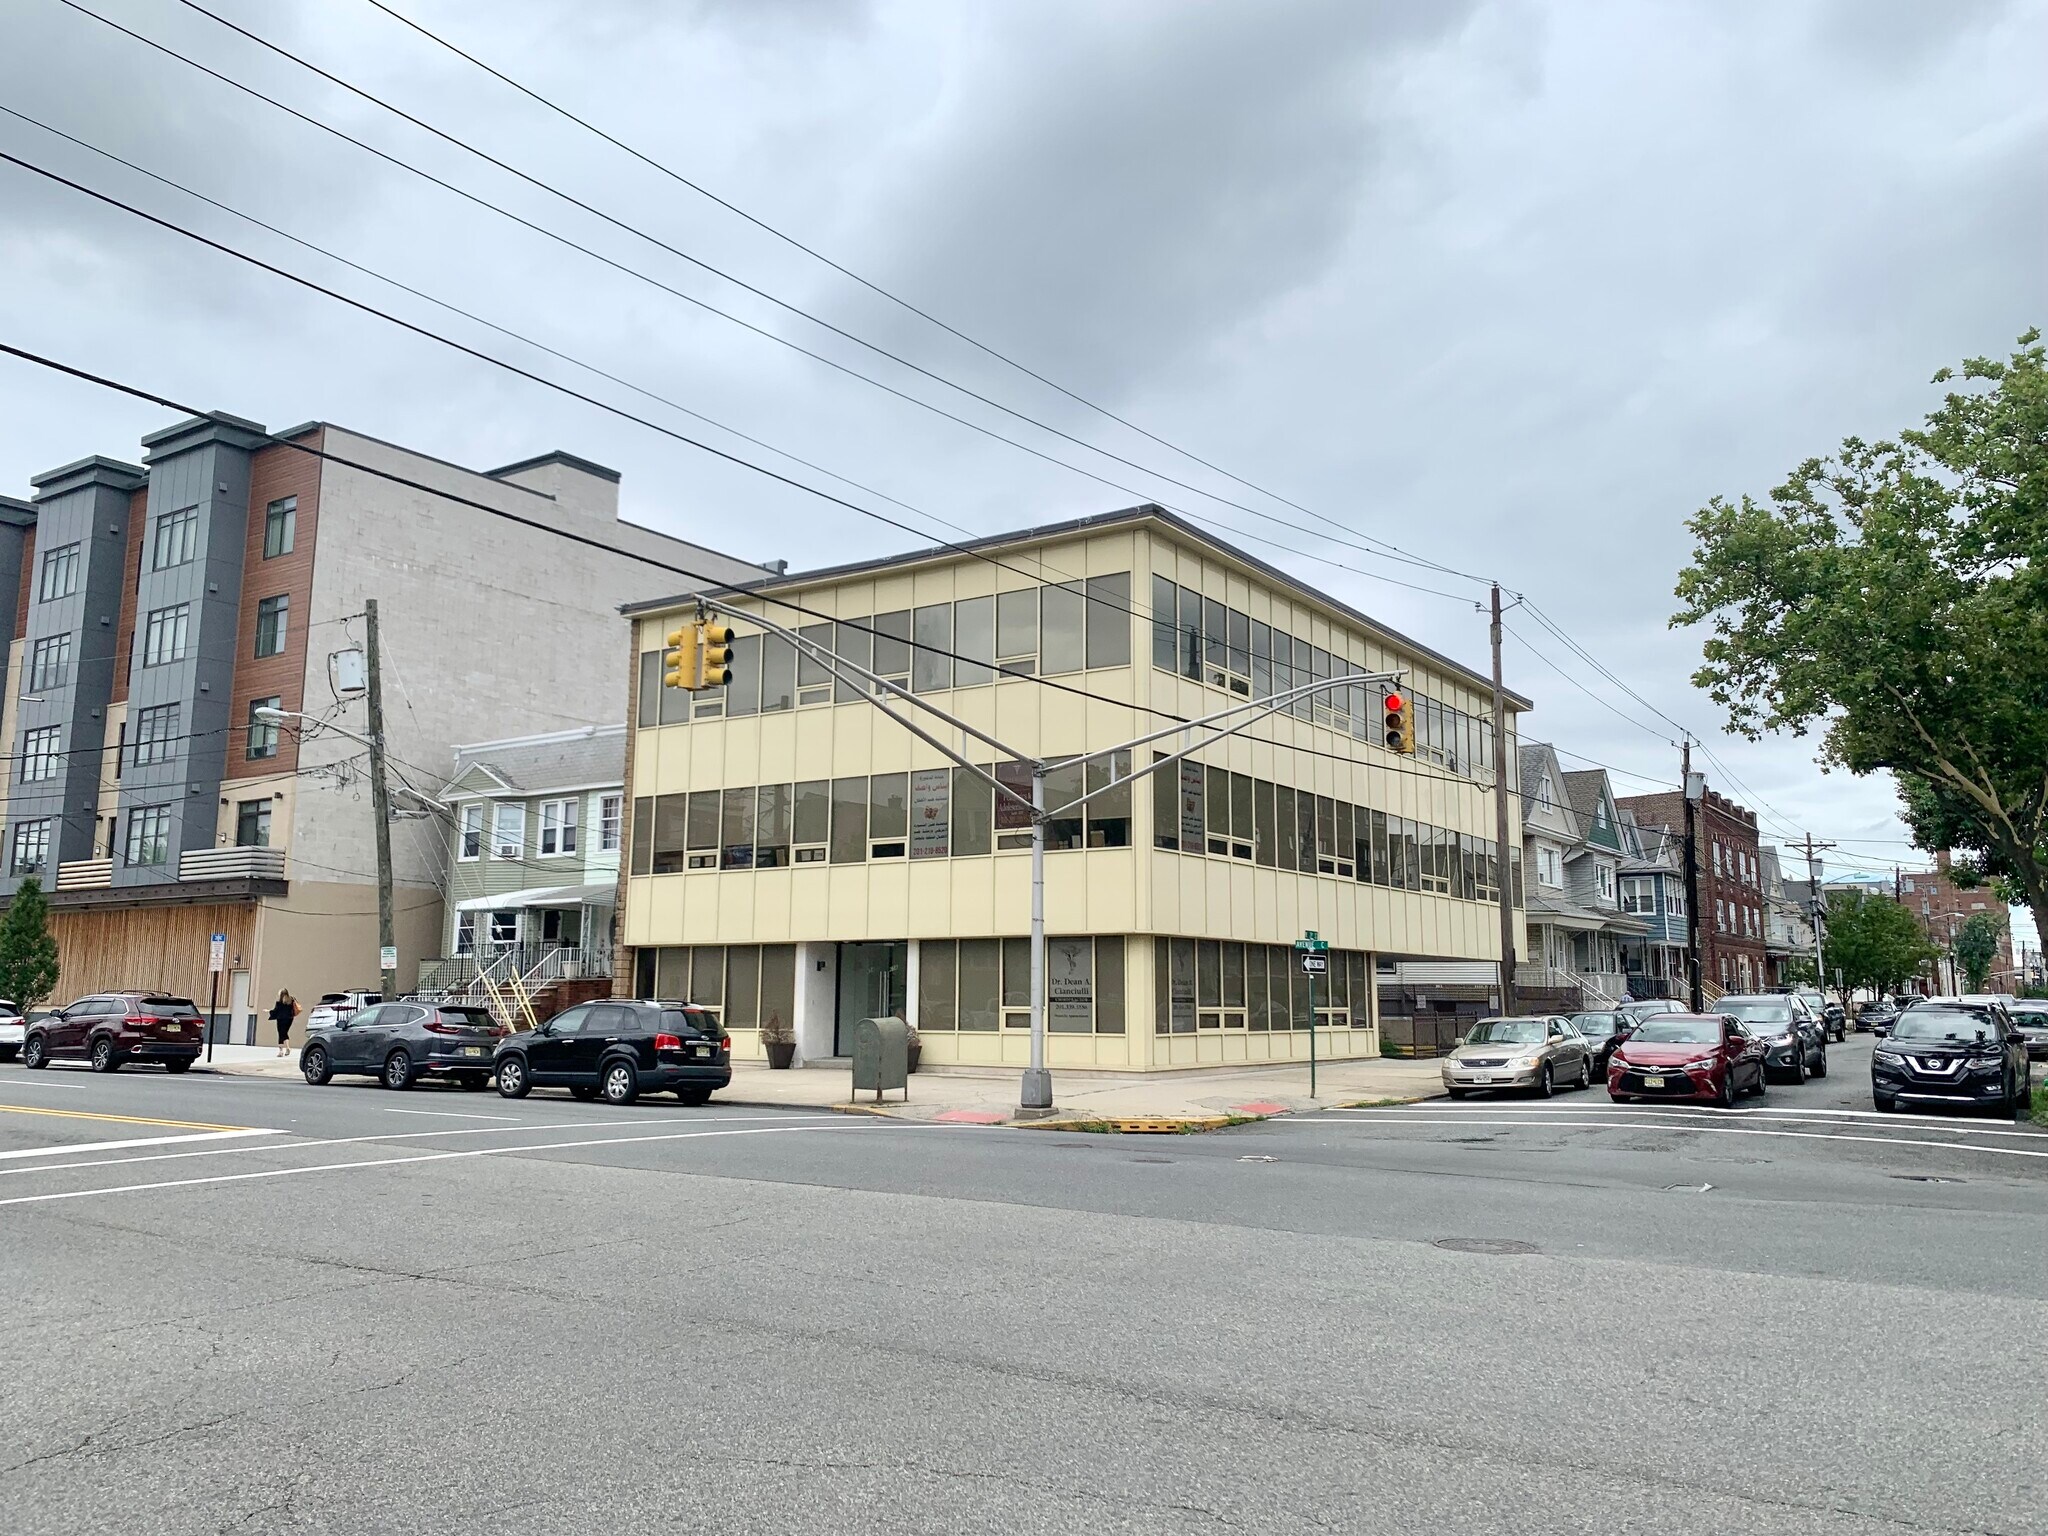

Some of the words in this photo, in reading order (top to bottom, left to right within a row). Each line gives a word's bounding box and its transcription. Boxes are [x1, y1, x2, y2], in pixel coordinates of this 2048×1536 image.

[1320, 941, 1325, 949] C
[1051, 978, 1062, 986] Dr.
[1064, 978, 1083, 986] Dean
[1054, 987, 1089, 995] Cianciulli
